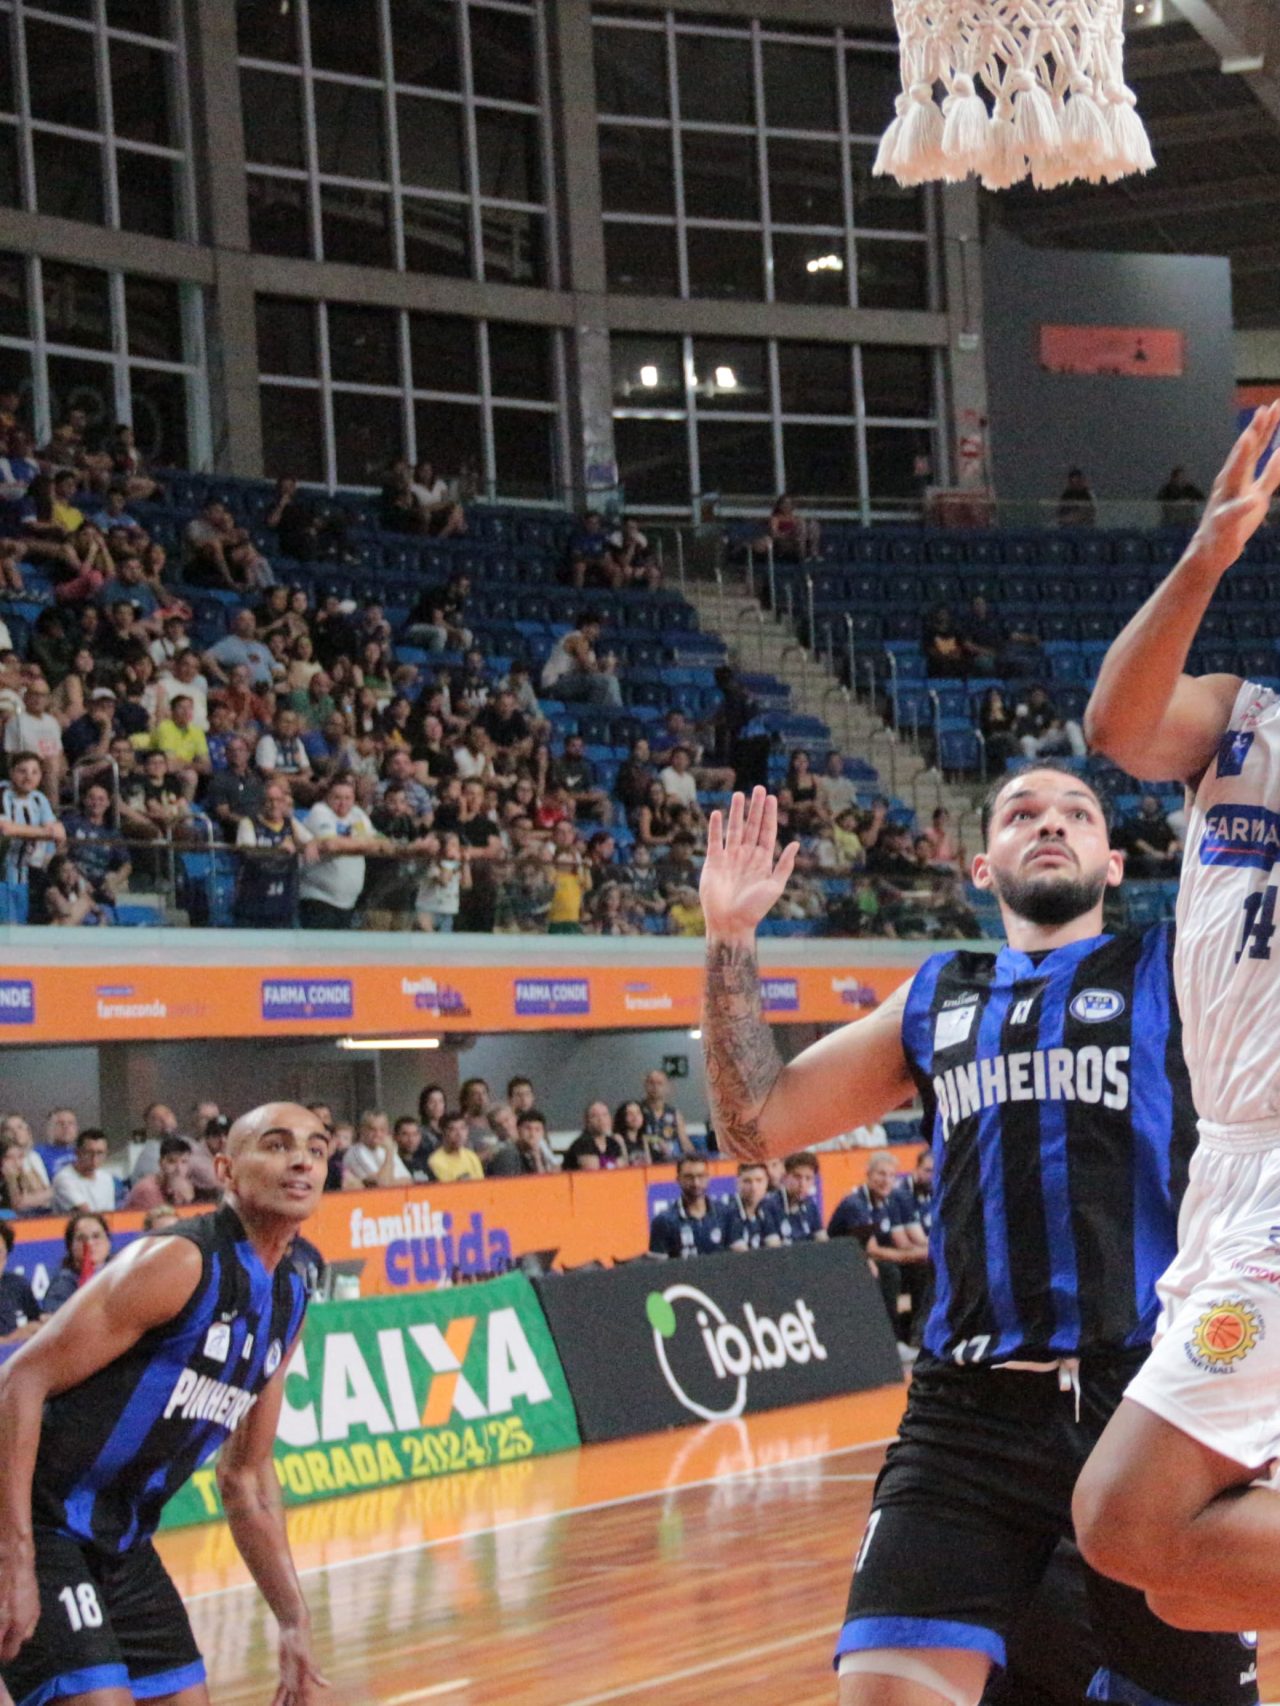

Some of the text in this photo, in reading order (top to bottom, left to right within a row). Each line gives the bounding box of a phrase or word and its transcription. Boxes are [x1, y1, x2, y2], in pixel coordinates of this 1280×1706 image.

[263, 985, 350, 1004] FARMA CONDE
[933, 1045, 1130, 1142] PINHEIROS
[385, 1212, 512, 1286] cuida
[697, 1299, 827, 1379] io.bet
[163, 1367, 258, 1433] PINHEIR
[276, 1307, 552, 1447] CAIXA
[402, 1416, 534, 1476] 2024/25
[59, 1583, 103, 1632] 18
